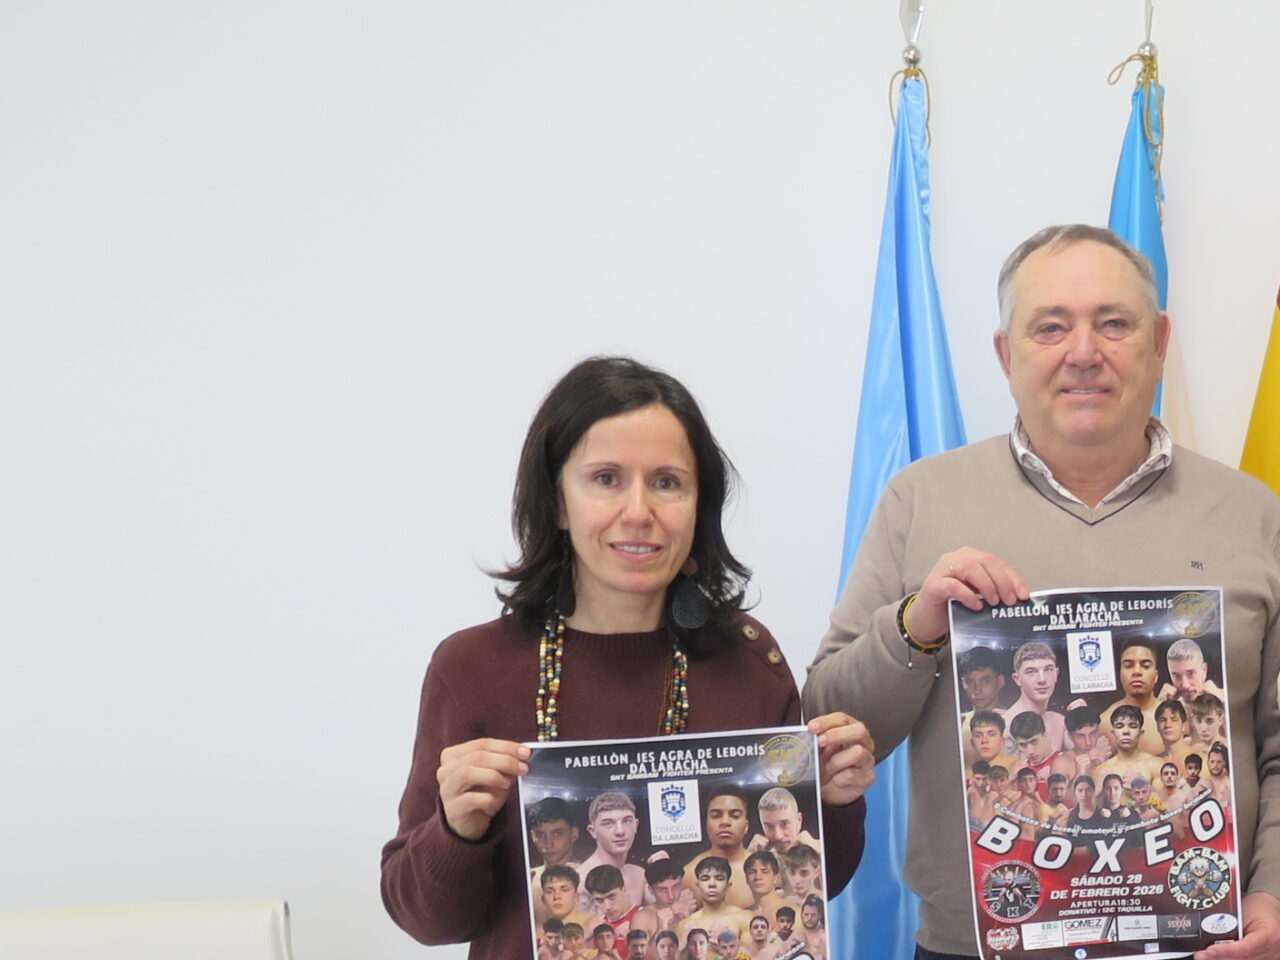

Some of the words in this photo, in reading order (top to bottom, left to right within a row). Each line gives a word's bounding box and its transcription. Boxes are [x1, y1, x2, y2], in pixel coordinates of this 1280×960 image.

[1056, 603, 1072, 615] IES
[1076, 601, 1106, 614] AGRA
[1110, 601, 1124, 611] DE
[1128, 598, 1174, 610] LEBORÍS
[1050, 615, 1066, 625] DA
[1069, 611, 1120, 624] LARACHA
[1074, 673, 1110, 682] CONCELLO
[1071, 683, 1081, 691] DA
[1082, 680, 1114, 689] LARACHA
[637, 751, 655, 763] IES
[659, 749, 693, 762] AGRA
[697, 748, 713, 759] DE
[717, 743, 766, 758] LEBORÍS
[629, 763, 647, 774] DA
[651, 759, 708, 773] LARACHA
[695, 767, 733, 775] PRESENTA
[1159, 807, 1183, 820] boxeo
[656, 824, 695, 834] CONCELLO
[664, 832, 699, 841] LARACHA
[976, 798, 1225, 874] BOXEO
[1170, 847, 1227, 875] BAM-BAM
[1070, 875, 1123, 887] SÁBADO
[1126, 874, 1143, 885] 28
[1050, 889, 1069, 900] DE
[1071, 887, 1131, 899] FEBRERO
[1134, 884, 1165, 896] 2026
[1169, 885, 1201, 910] FIGHT
[1201, 881, 1231, 909] CLUB
[990, 898, 1035, 918] SKT
[1058, 907, 1096, 916] DONATIVO
[1117, 905, 1153, 913] TAQUILLA
[1064, 918, 1102, 929] GOMEZ
